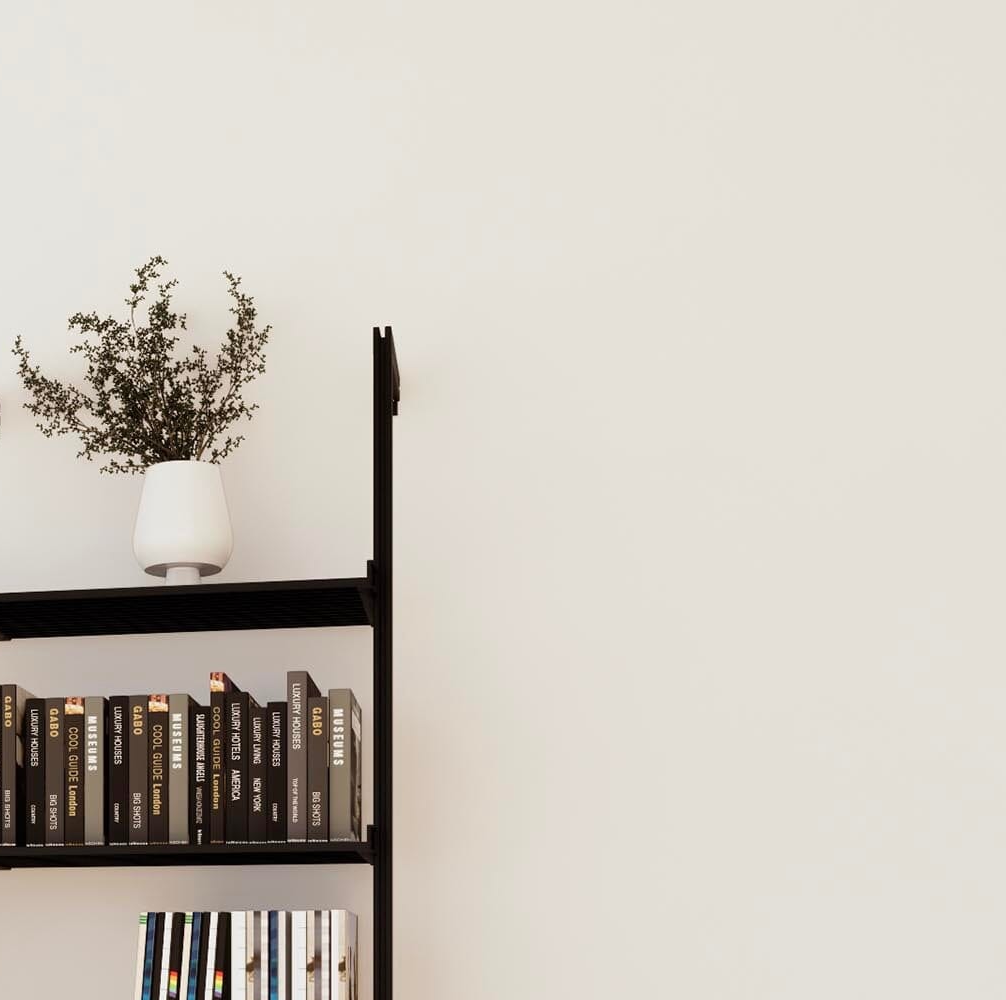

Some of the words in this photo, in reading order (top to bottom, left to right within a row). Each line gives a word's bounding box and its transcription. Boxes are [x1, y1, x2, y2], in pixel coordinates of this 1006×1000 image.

[4, 696, 12, 727] GABO
[292, 683, 301, 715] LUXURY
[50, 708, 59, 737] GABO
[114, 706, 122, 734] LUXURY
[133, 705, 143, 736] GABO
[212, 706, 221, 734] COOL
[231, 702, 241, 732] LUXURY
[253, 717, 261, 743] LUXURY
[272, 711, 281, 737] LUXURY
[312, 707, 323, 736] GABO
[68, 727, 79, 752] COOL
[87, 715, 97, 771] MUSEUMS
[153, 724, 163, 750] COOL
[172, 713, 182, 769] MUSEUMS
[196, 714, 205, 761] SLAUGHTERHOUSE
[231, 732, 241, 761] HOTELS
[292, 717, 301, 750] HOUSES
[332, 708, 344, 766] MUSEUMS
[114, 735, 122, 765] HOUSES
[212, 738, 221, 770] GUIDE
[253, 743, 261, 765] LIVING
[272, 739, 281, 767] HOUSES
[68, 755, 79, 782] GUIDE
[153, 753, 163, 780] GUIDE
[196, 762, 205, 783] ANGELS
[133, 792, 141, 805] BIG
[153, 783, 162, 815] London
[212, 774, 221, 810] London
[231, 769, 241, 801] AMERICA
[253, 778, 261, 793] NEW
[312, 791, 321, 803] BIG
[69, 786, 78, 817] London
[253, 794, 261, 812] YORK
[312, 804, 321, 827] SHOTS
[133, 805, 141, 829] SHOTS
